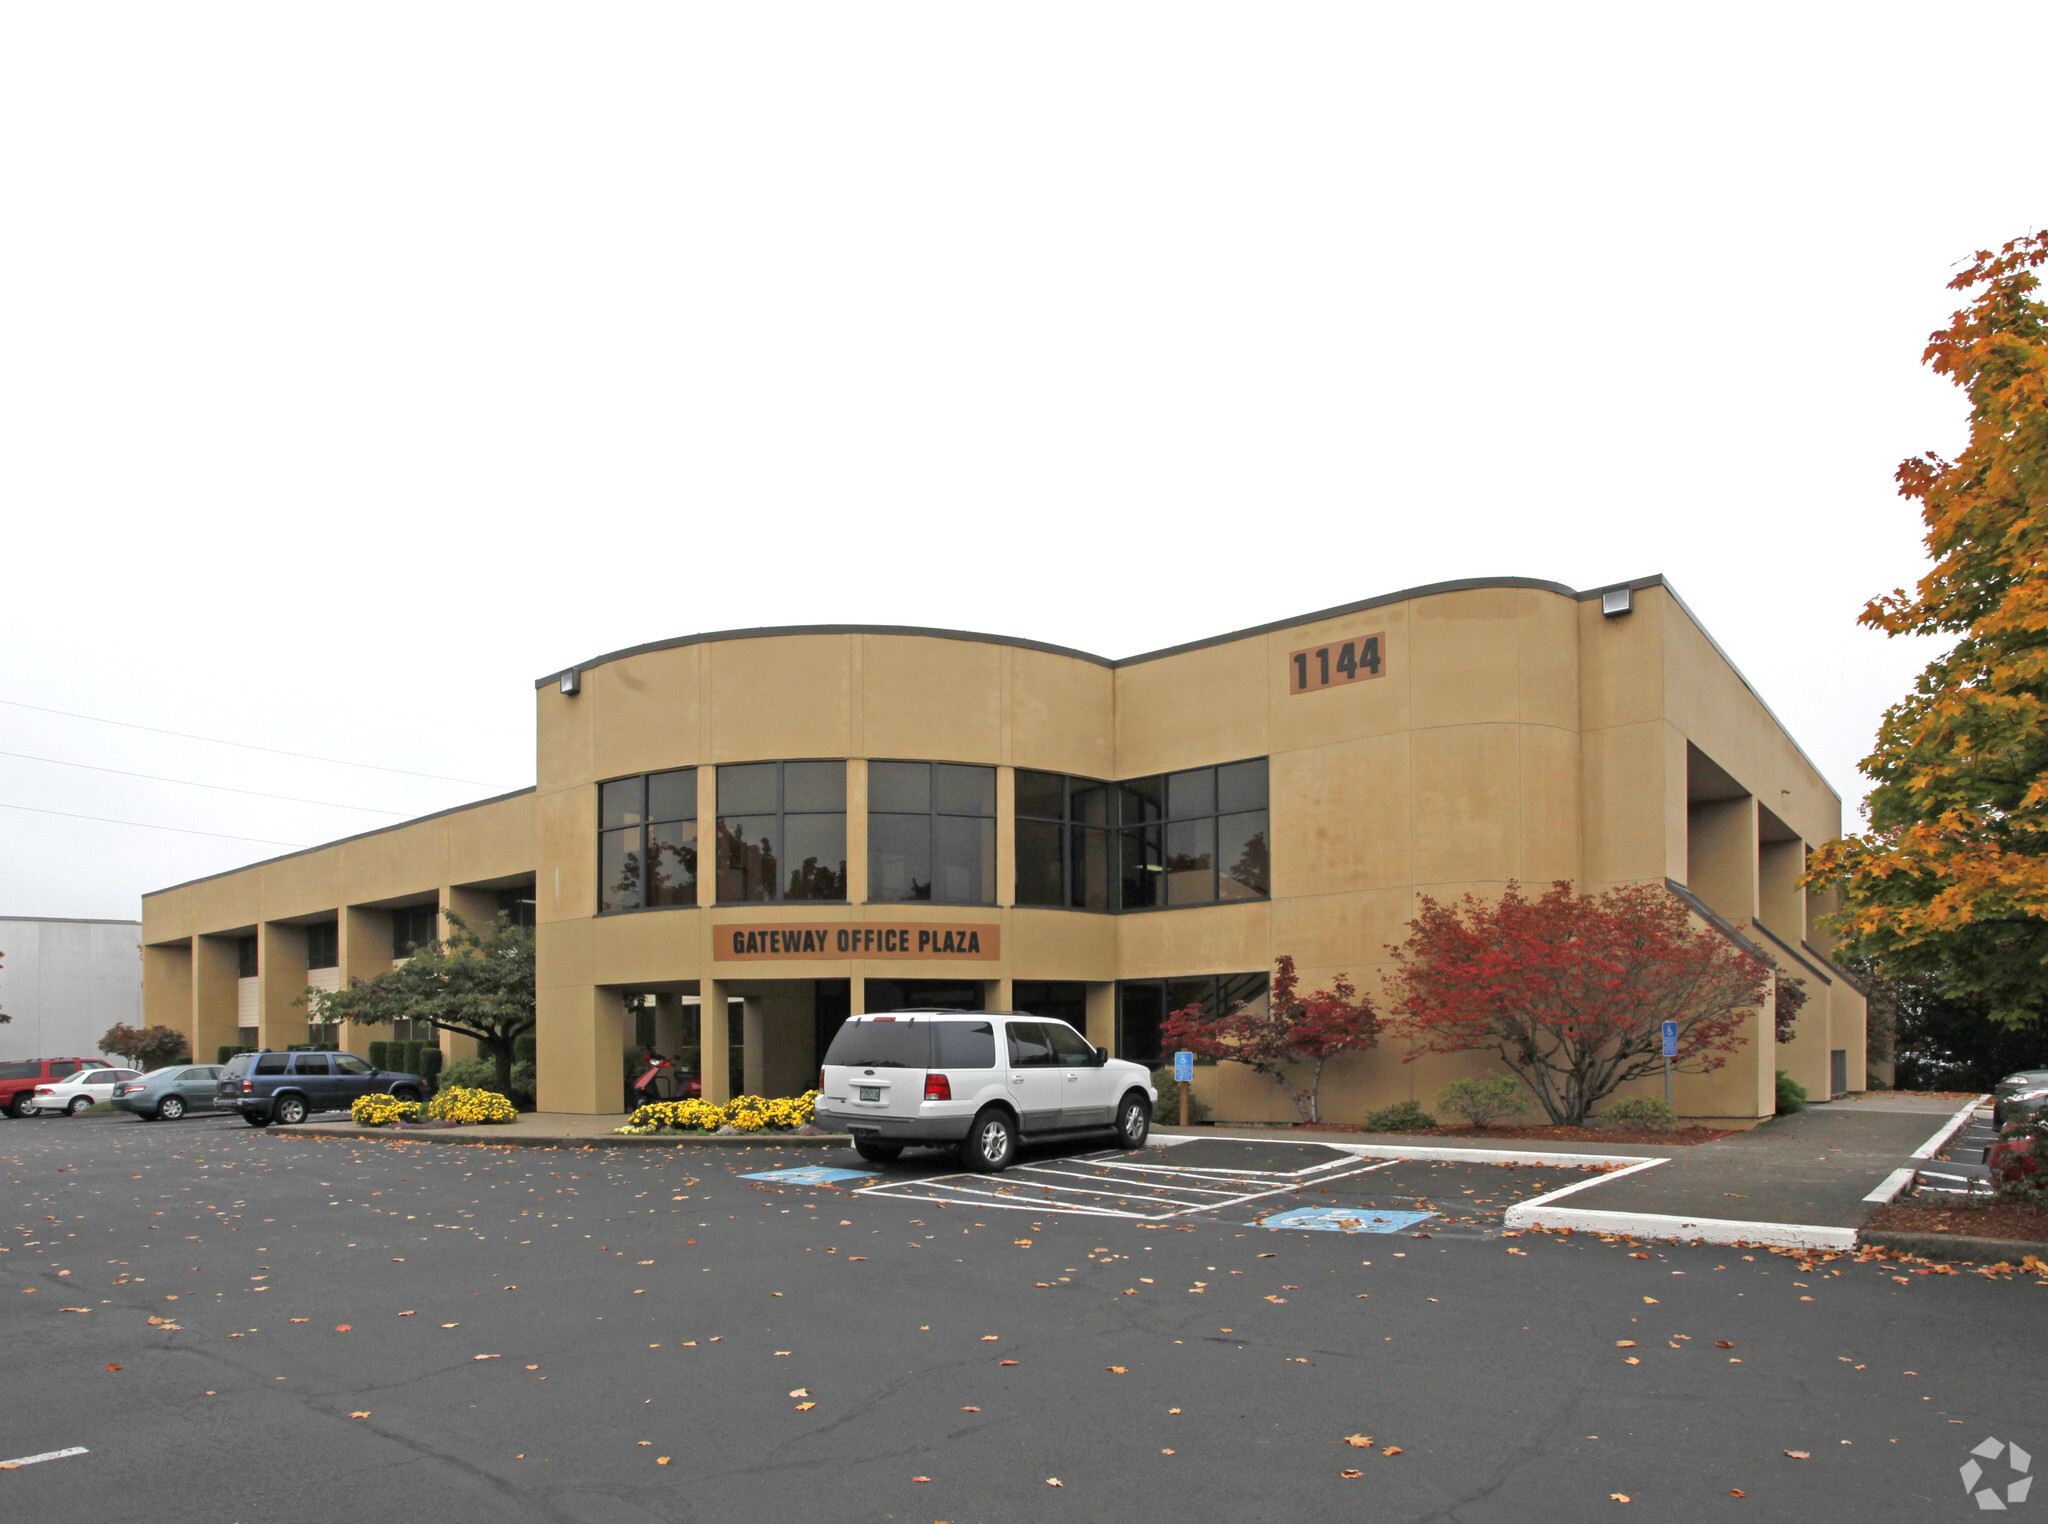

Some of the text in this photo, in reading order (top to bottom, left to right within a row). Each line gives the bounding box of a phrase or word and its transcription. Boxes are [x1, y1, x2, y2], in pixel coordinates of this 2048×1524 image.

[1293, 636, 1381, 689] 1144
[732, 928, 981, 955] GATEWAY OFFICE PLAZA
